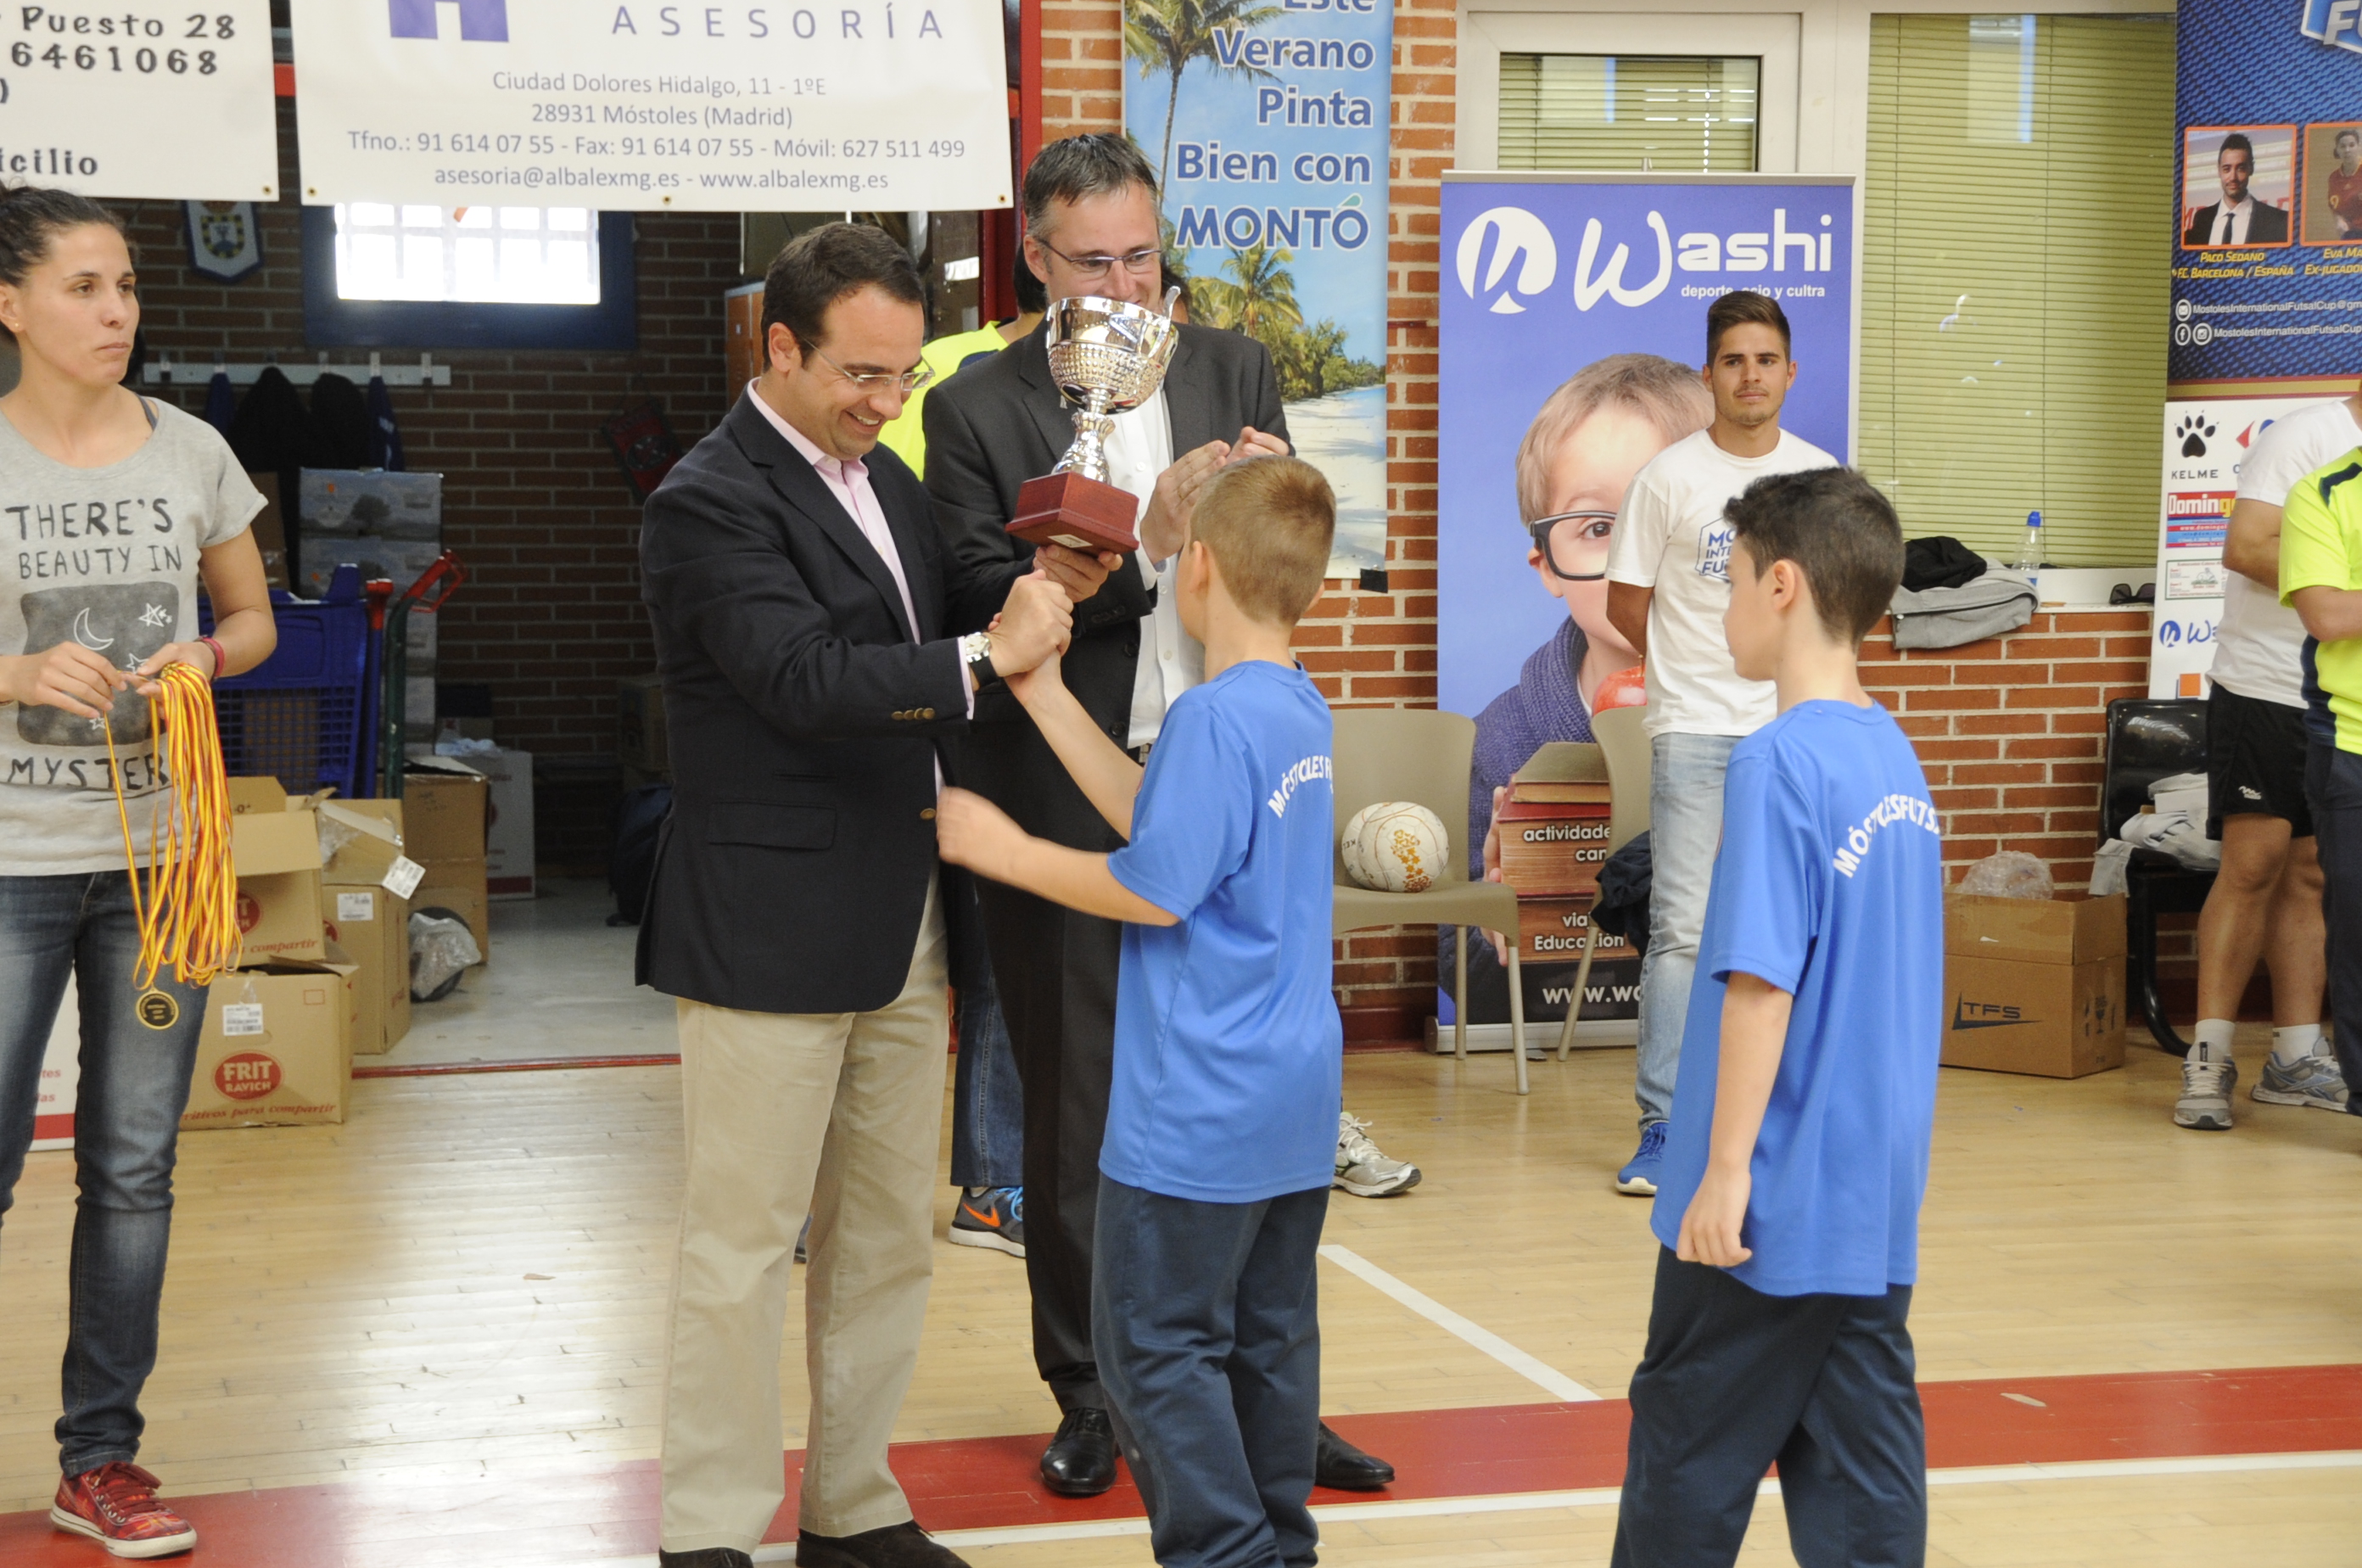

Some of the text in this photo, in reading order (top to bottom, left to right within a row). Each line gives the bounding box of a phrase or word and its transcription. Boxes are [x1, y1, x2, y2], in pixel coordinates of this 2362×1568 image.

[21, 6, 235, 39] Puesto 28
[612, 2, 943, 39] ASESORÍA
[2323, 0, 2362, 45] F
[11, 42, 217, 75] 6461068
[1212, 29, 1375, 70] Verano
[493, 71, 565, 91] Ciudad
[574, 73, 652, 92] Dolores
[658, 76, 742, 98] Hidalgo,
[749, 77, 772, 95] 11
[793, 78, 826, 96] 1ºE
[532, 104, 793, 129] 28931 Móstoles (Madrid)
[1257, 87, 1372, 126] Pinta
[348, 131, 411, 152] Tfno.:
[417, 133, 442, 153] 91
[451, 134, 490, 153] 614
[496, 135, 522, 154] 07
[529, 136, 554, 154] 55
[575, 137, 615, 155] Fax:
[621, 137, 647, 156] 91
[654, 137, 691, 156] 614
[697, 138, 722, 157] 07
[729, 138, 753, 157] 55
[774, 138, 836, 159] Móvil:
[842, 139, 879, 159] 627
[886, 140, 921, 159] 511
[928, 140, 966, 159] 499
[1177, 143, 1371, 182] Bien con
[434, 167, 680, 192] asesoria@albalexmg.es
[700, 170, 888, 193] www.albalexmg.es
[1175, 193, 1369, 250] MONTÓ
[1574, 208, 1832, 312] Washi
[2304, 264, 2362, 276] EX-JUGADO
[1774, 287, 1783, 300] y
[1786, 284, 1825, 297] cultra
[2171, 469, 2219, 479] KELME
[5, 498, 172, 540] THERE'S
[19, 545, 182, 580] BEAUTY IN
[1701, 558, 1729, 574] FU
[1562, 911, 1592, 930] via
[1534, 933, 1624, 950] Educaión
[1963, 1001, 2021, 1020] TFS
[223, 1061, 273, 1081] FRIT
[225, 1081, 271, 1093] RAVICH
[232, 1106, 266, 1119] para
[268, 1104, 337, 1116] compartir
